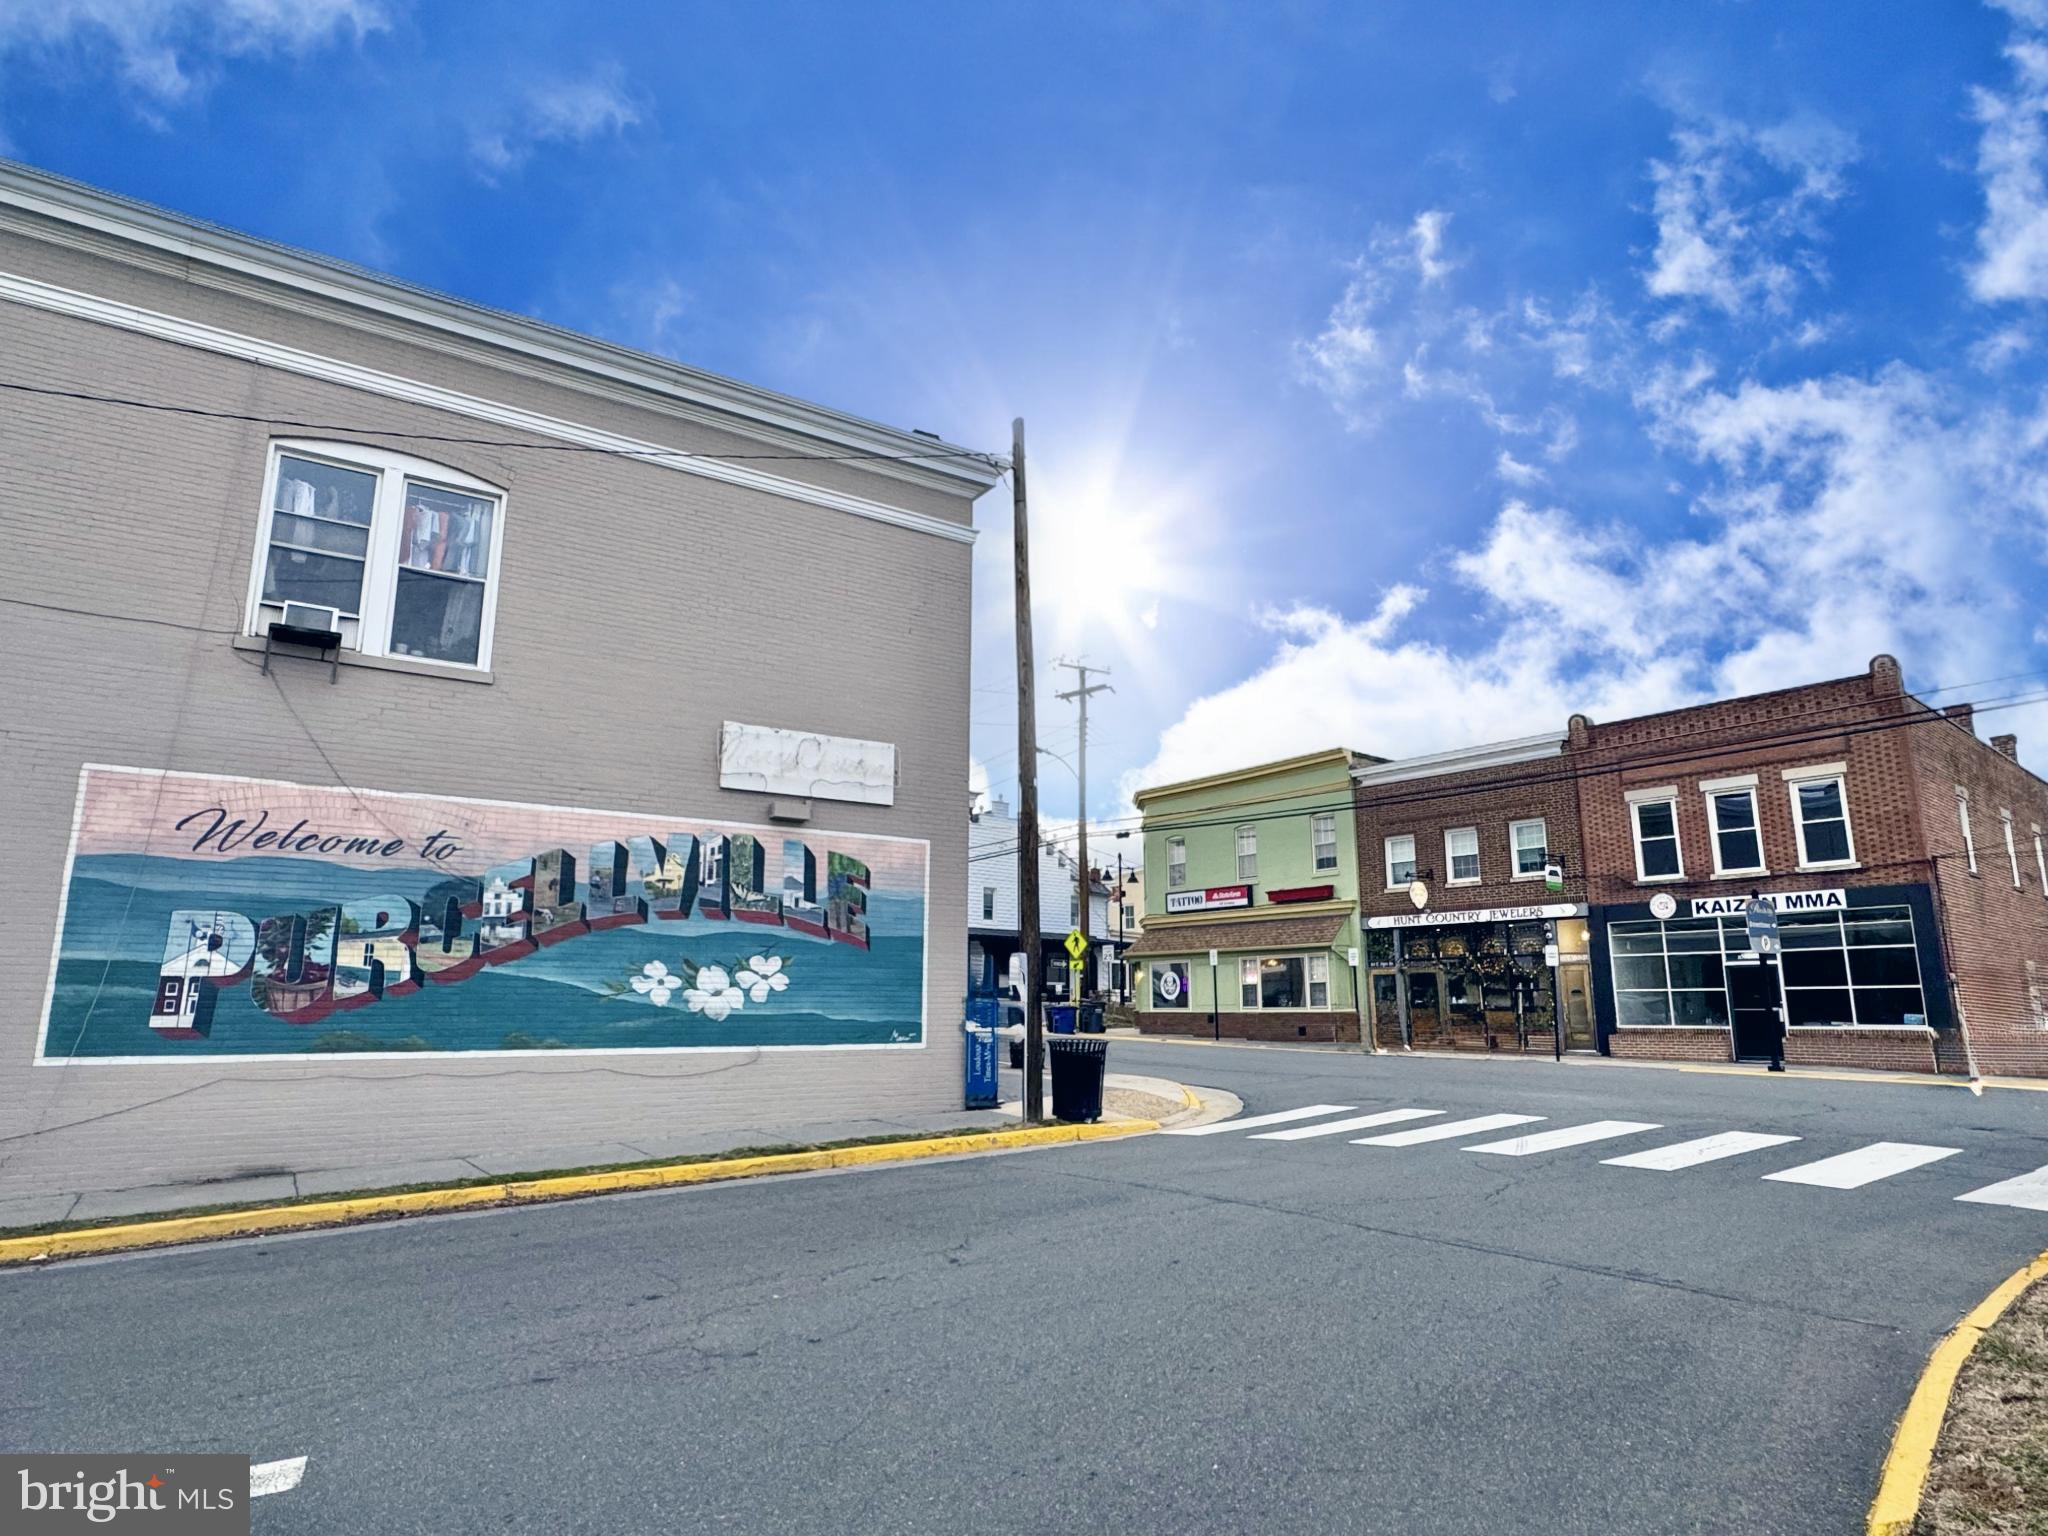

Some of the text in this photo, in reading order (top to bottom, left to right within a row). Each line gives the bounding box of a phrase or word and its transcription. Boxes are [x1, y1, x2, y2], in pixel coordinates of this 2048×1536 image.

[175, 808, 463, 860] Welcome to
[1170, 895, 1203, 907] TATTOO
[1695, 896, 1777, 914] KAIZN
[1785, 892, 1842, 909] MMA
[1393, 906, 1544, 926] HUNT COUNTRY JEWELERS
[150, 832, 871, 1038] PURCELLVILLE
[1103, 953, 1113, 961] 25
